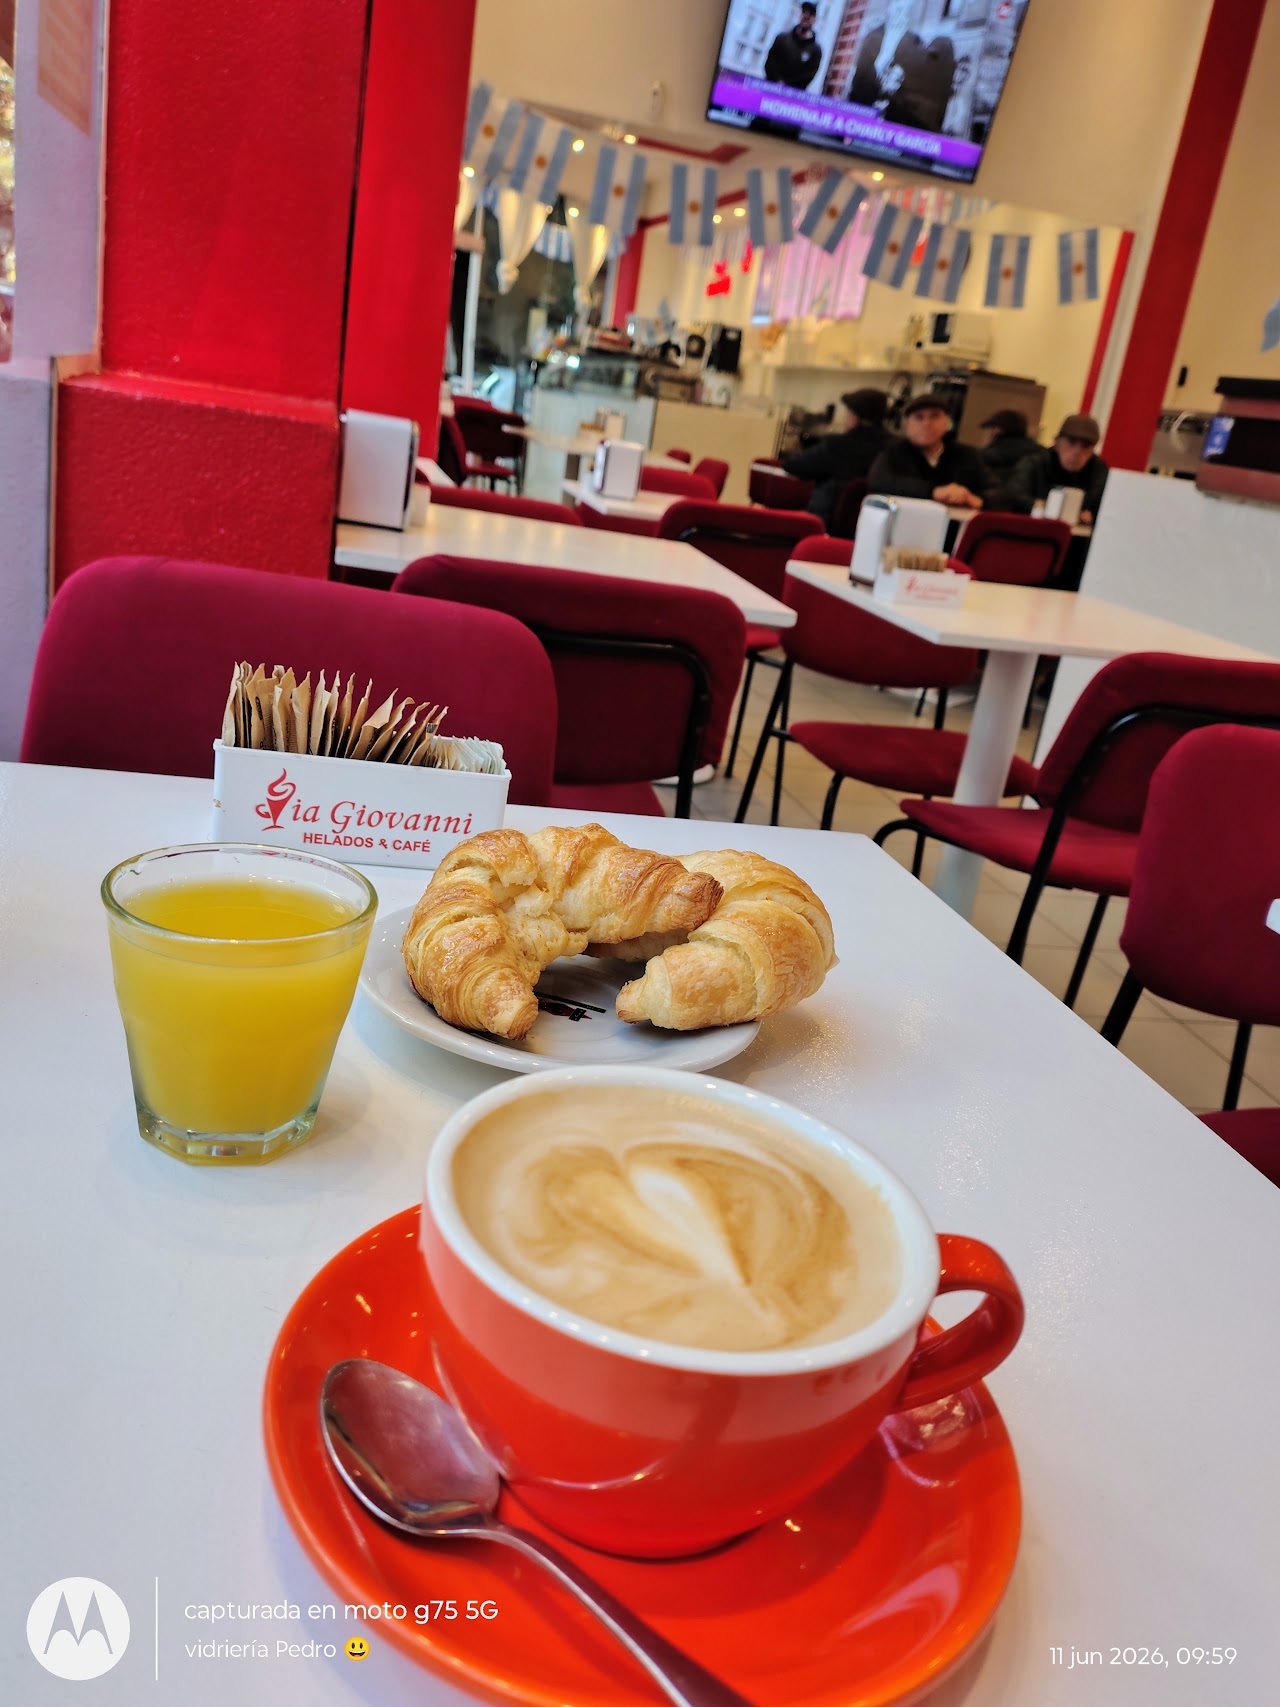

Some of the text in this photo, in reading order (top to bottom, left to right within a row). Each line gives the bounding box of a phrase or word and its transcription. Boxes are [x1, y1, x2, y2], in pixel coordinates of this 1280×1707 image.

[759, 97, 832, 128] HOMENAJE
[330, 800, 473, 835] Giovanni
[302, 832, 431, 852] HELADOS & CAFÉ
